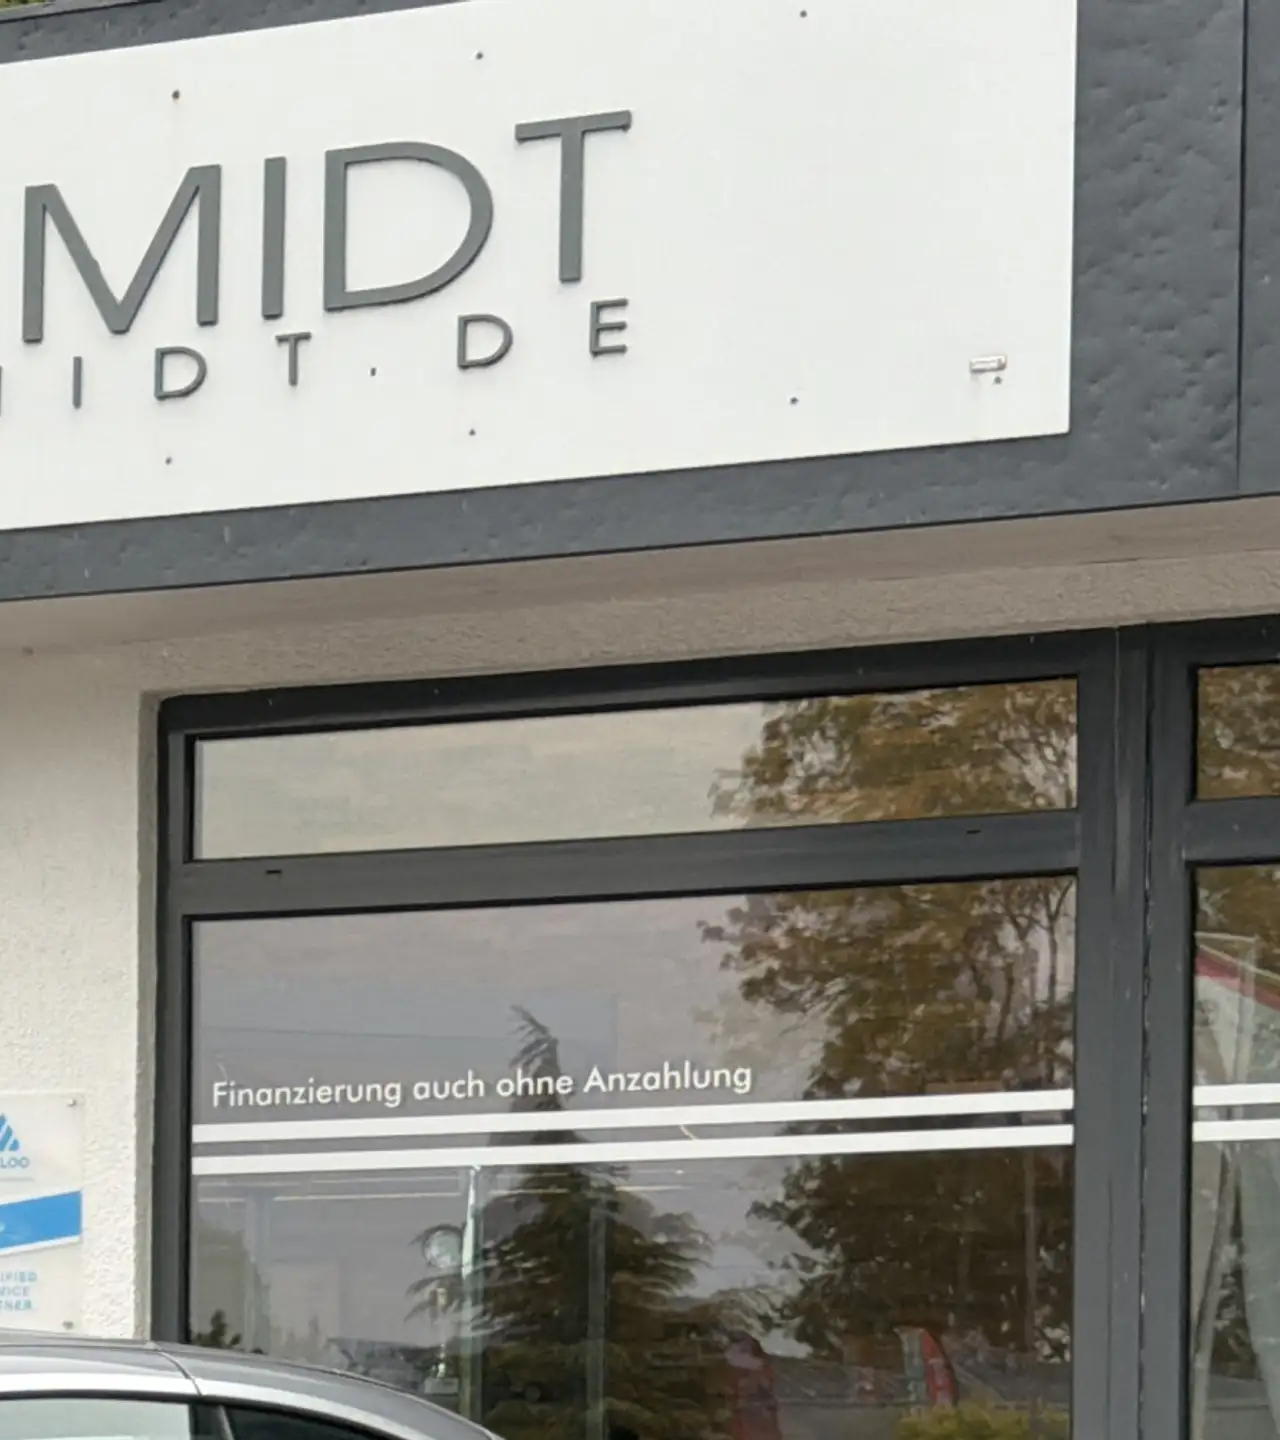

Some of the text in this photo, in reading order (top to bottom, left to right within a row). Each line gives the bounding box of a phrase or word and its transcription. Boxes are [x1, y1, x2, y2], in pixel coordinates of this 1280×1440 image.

[211, 1062, 754, 1110] Finanzierung auch ohne Anzahlung
